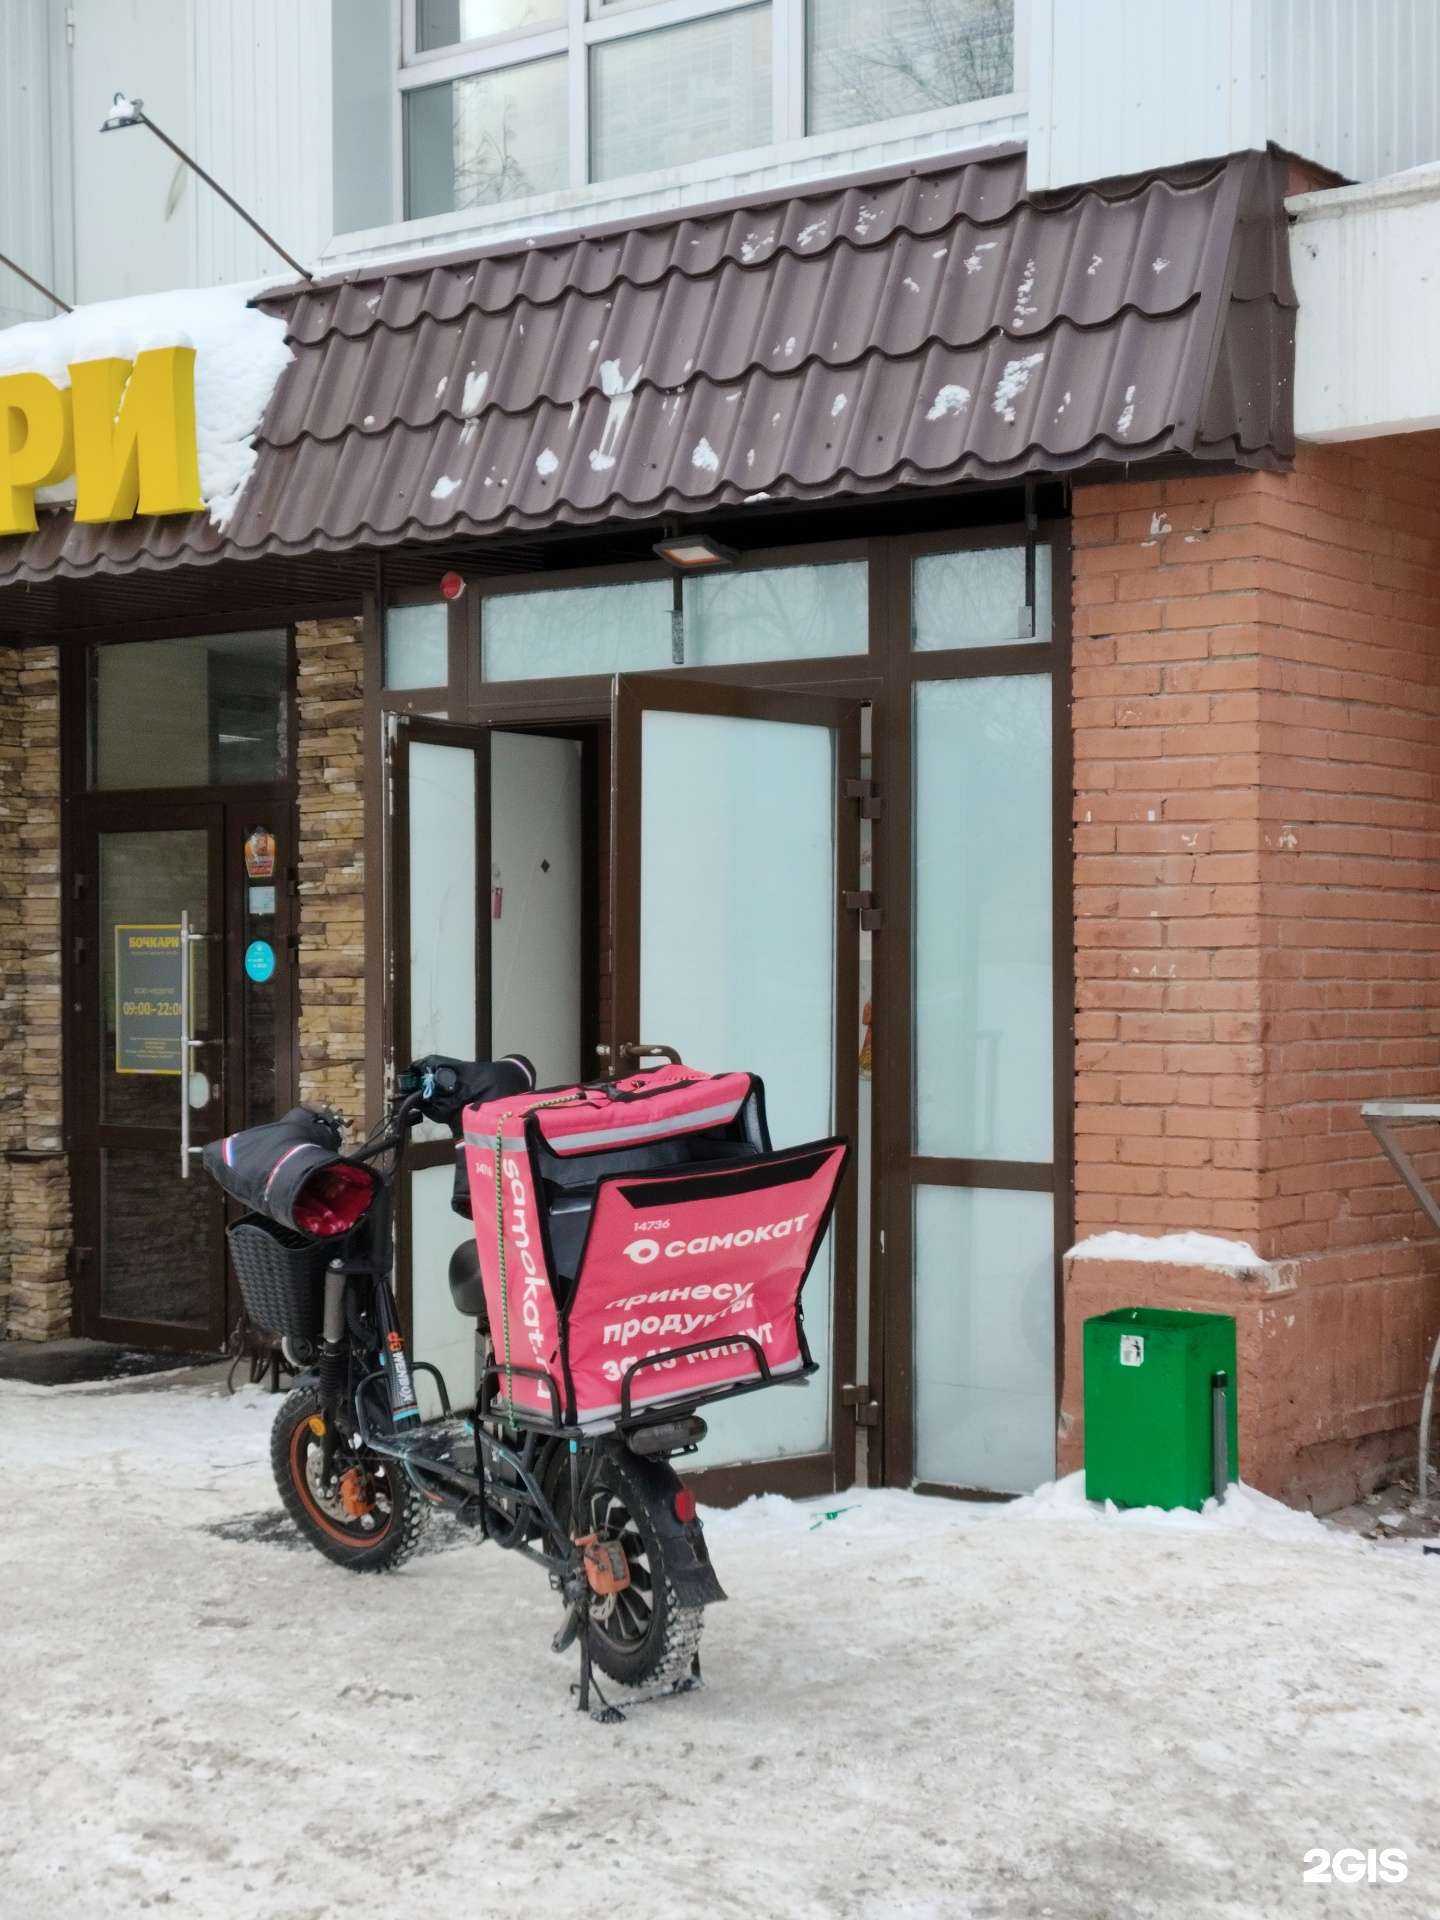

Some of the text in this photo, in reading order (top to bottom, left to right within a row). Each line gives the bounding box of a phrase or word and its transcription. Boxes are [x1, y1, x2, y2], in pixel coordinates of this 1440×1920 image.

[128, 936, 179, 948] БОЧКАРИ
[633, 1218, 671, 1232] 14736
[664, 1213, 809, 1258] самокат
